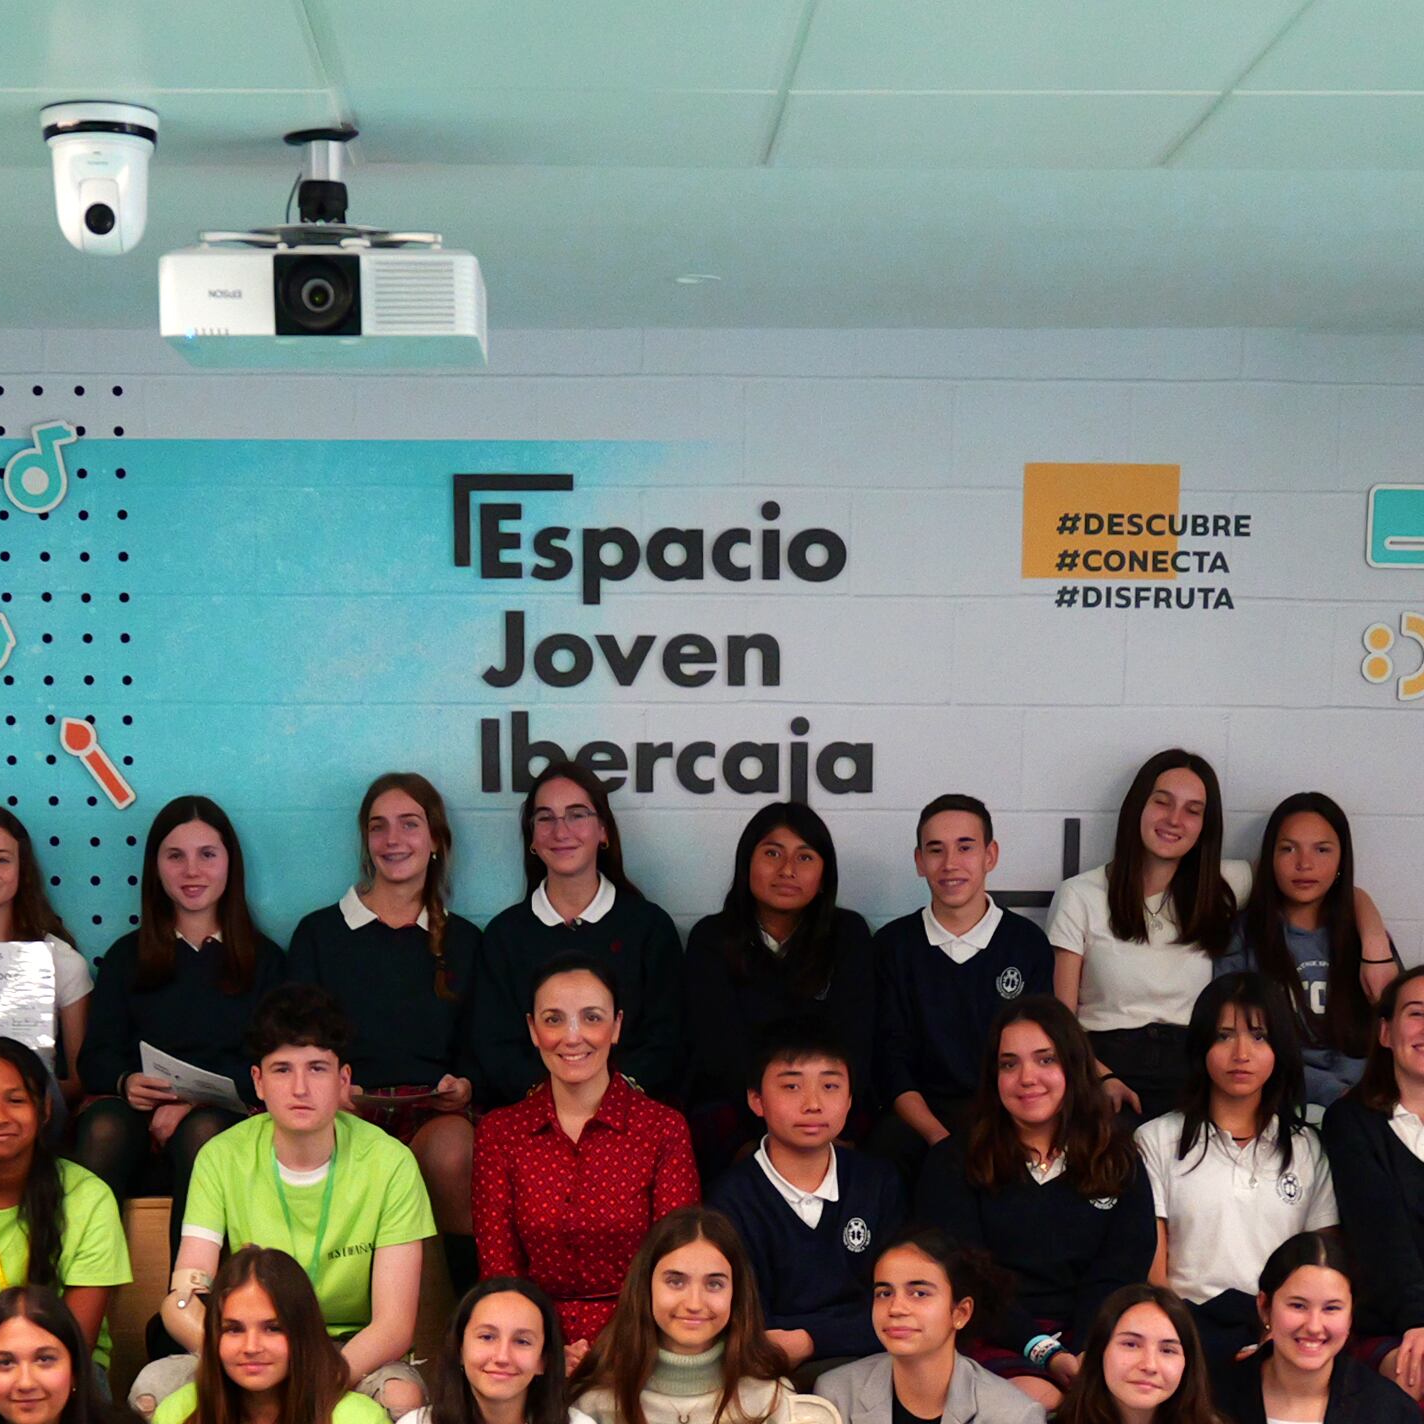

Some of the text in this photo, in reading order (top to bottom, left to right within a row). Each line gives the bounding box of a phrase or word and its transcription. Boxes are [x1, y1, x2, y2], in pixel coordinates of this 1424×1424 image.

[1057, 513, 1252, 537] #DESCUBRE
[480, 501, 848, 605] Espacio
[1055, 549, 1231, 574] #CONECTA
[1054, 586, 1236, 610] #DISFRUTA
[481, 610, 781, 688] Joven
[480, 711, 875, 806] Ibercaja
